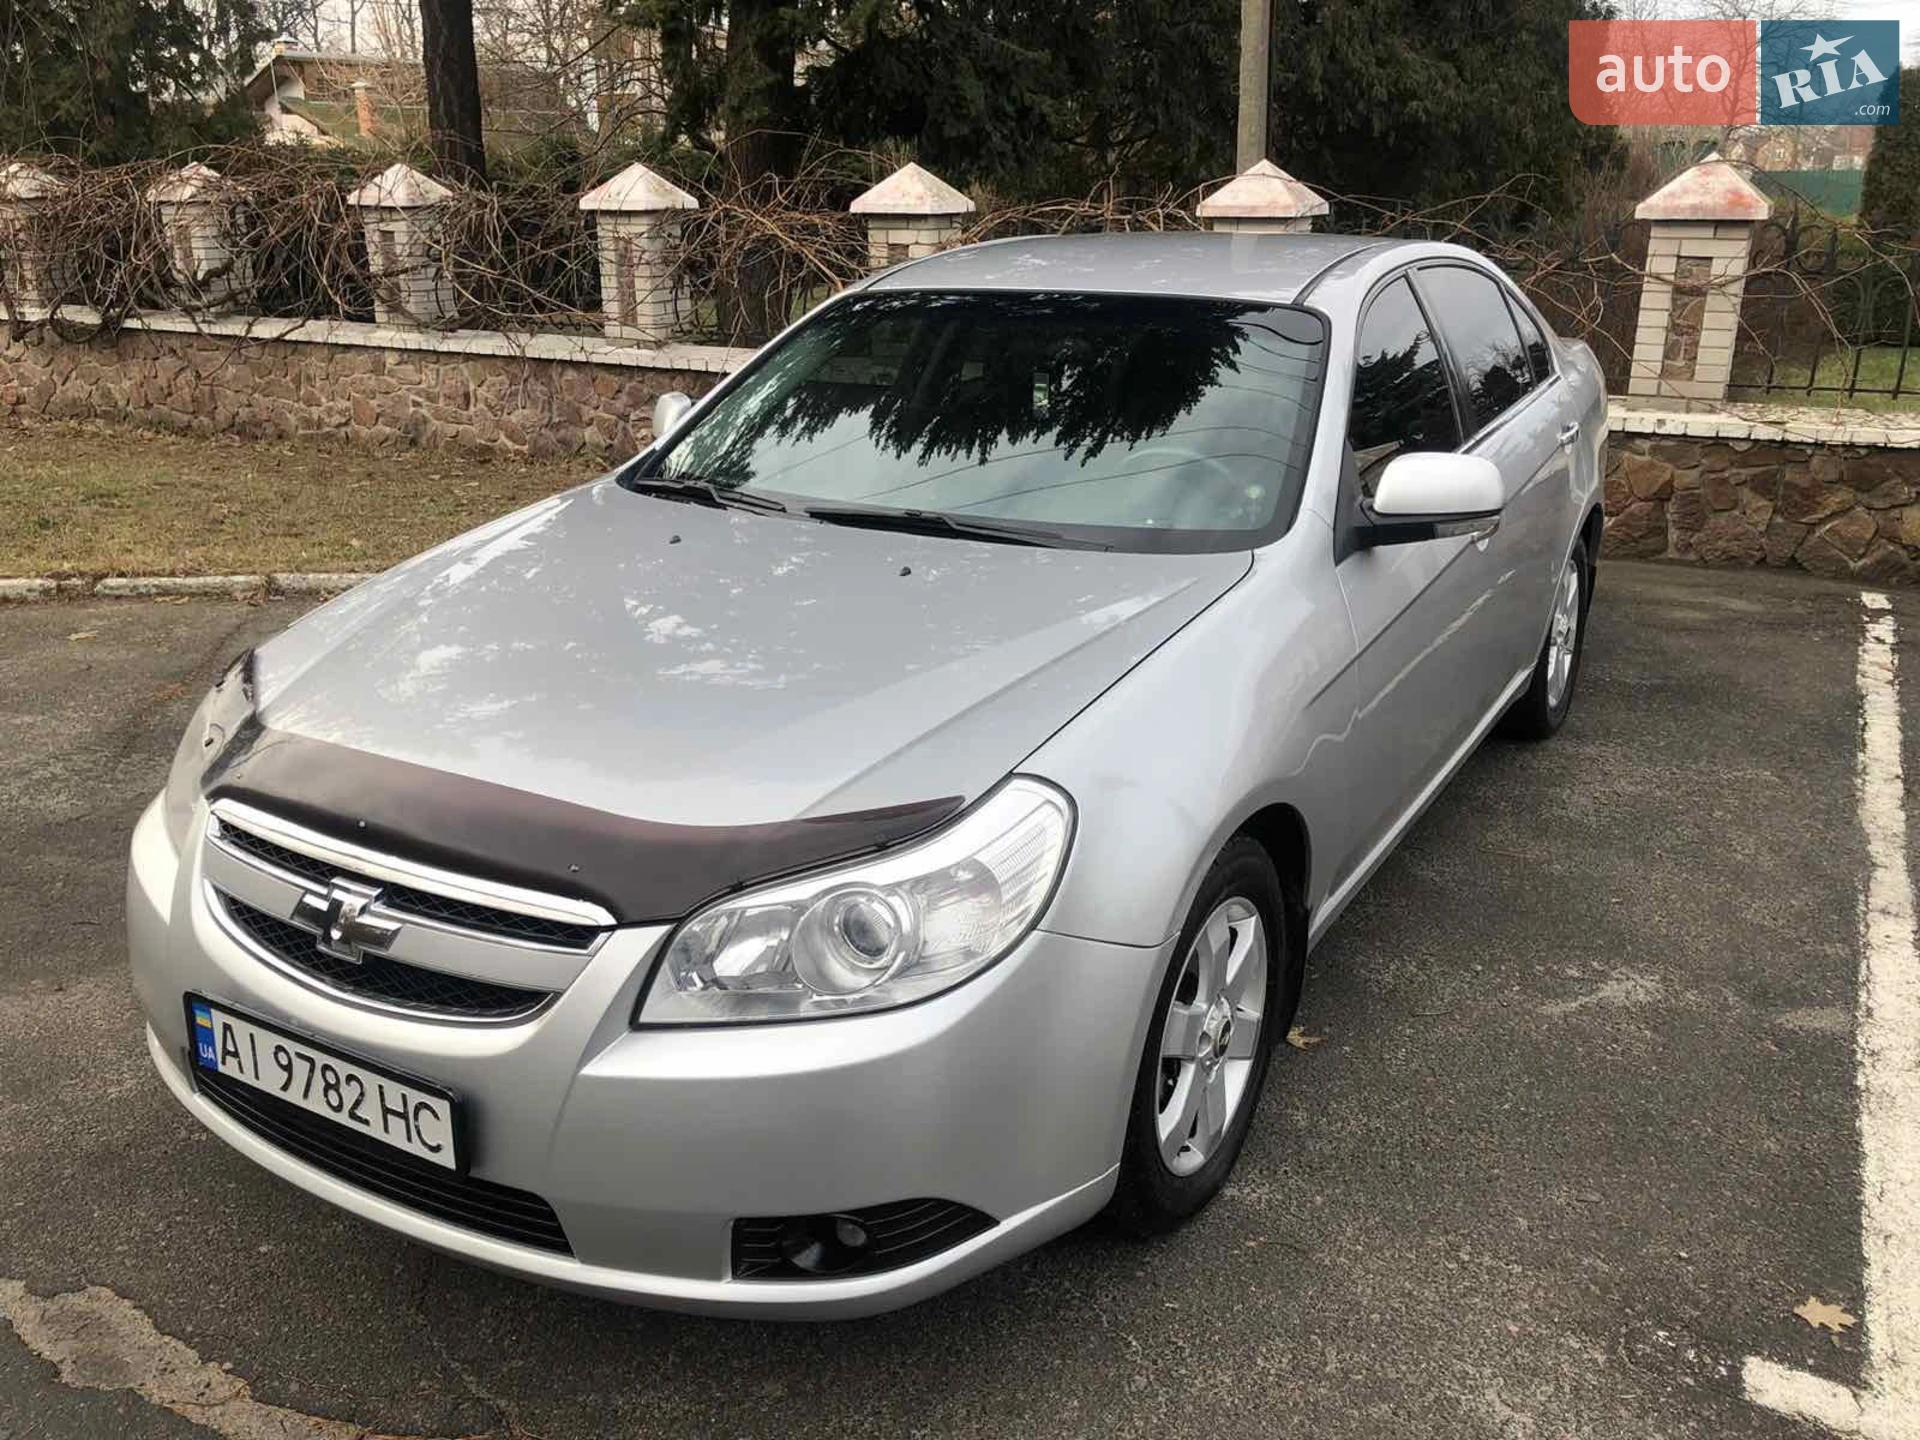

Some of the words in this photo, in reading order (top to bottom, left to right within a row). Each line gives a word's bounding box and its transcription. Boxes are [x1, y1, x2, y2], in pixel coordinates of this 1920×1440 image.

[199, 1041, 216, 1062] UA
[220, 1021, 260, 1081] AI
[273, 1044, 370, 1127] 9782
[378, 1084, 443, 1154] HC
